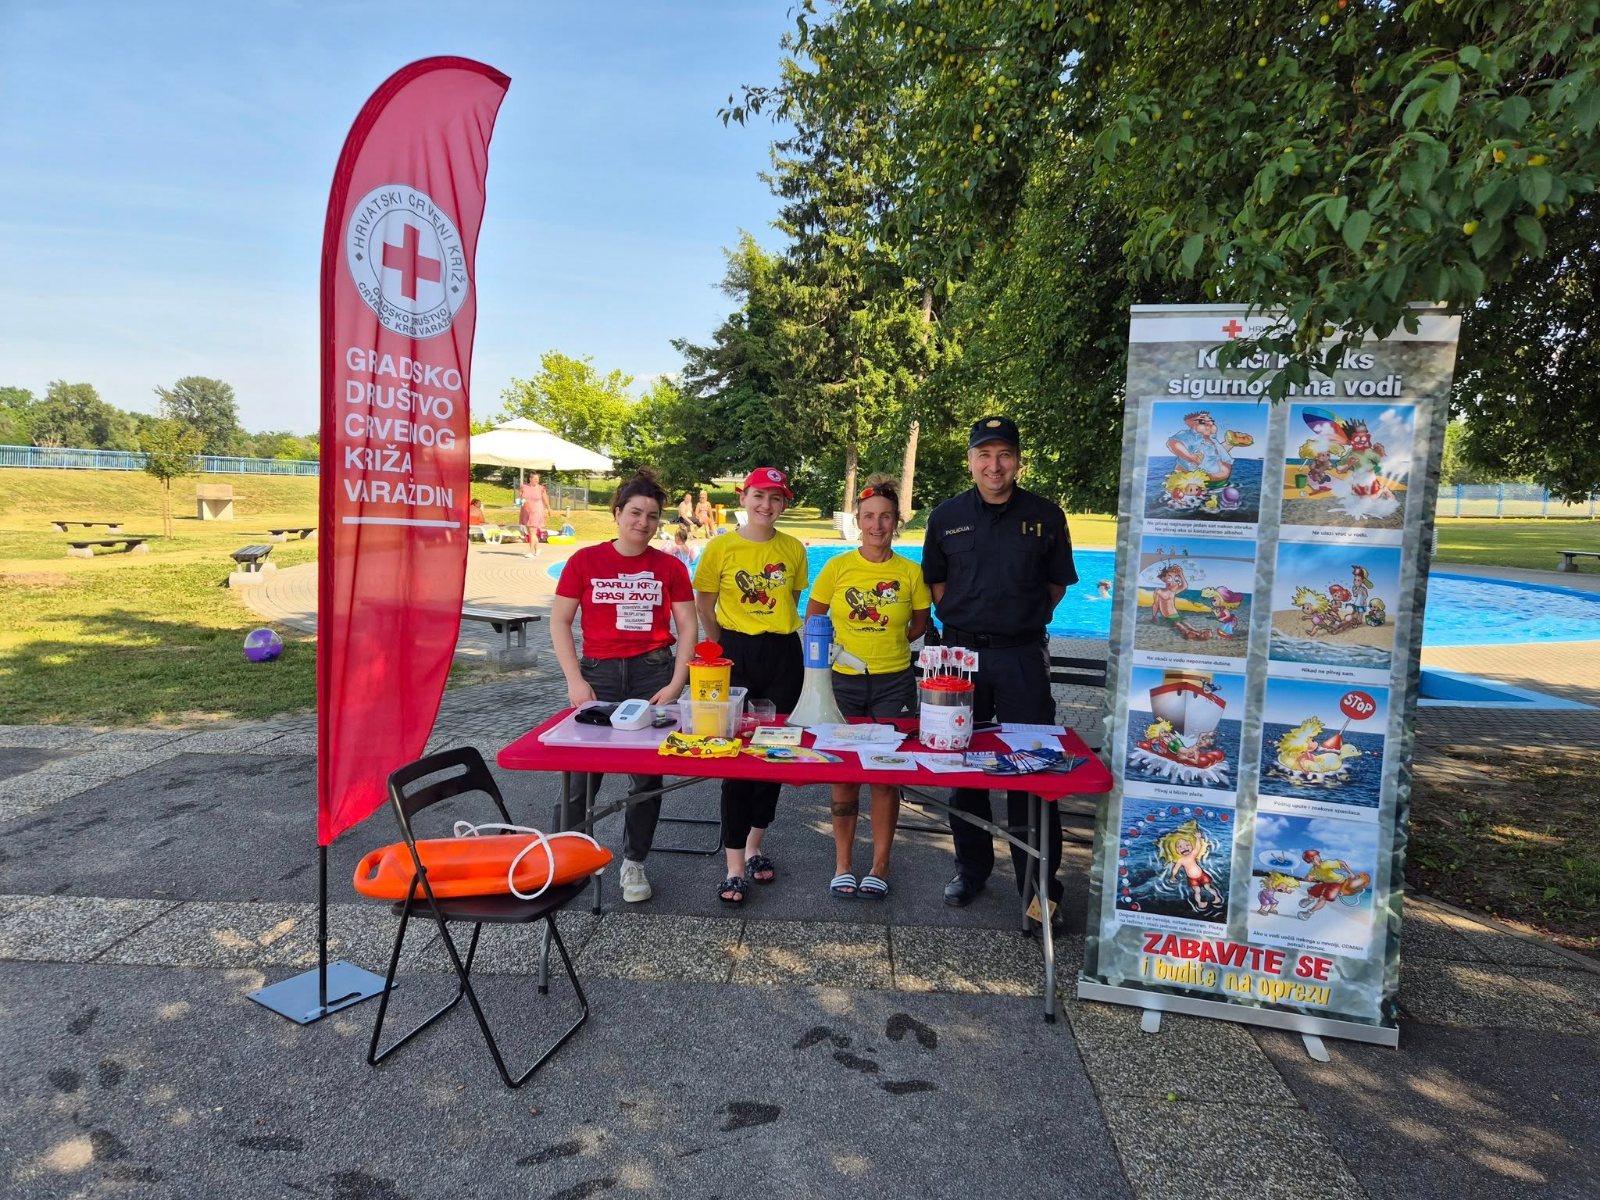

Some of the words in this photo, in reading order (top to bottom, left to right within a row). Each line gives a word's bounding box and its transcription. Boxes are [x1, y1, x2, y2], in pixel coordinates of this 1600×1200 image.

[353, 192, 402, 249] HRVATSKI
[408, 193, 454, 241] CRVENI
[448, 244, 467, 284] KRIŽ
[345, 347, 462, 391] GRADSKO
[1303, 379, 1336, 396] na
[1344, 374, 1402, 396] vodi
[345, 380, 454, 420] DRUŠTVO
[344, 413, 456, 450] CRVENOG
[344, 443, 412, 473] KRIŽA
[343, 478, 453, 508] VARAŽDIN
[945, 526, 970, 536] POLICIJA
[595, 581, 634, 589] DARUJ
[595, 591, 625, 601] SPASI
[628, 590, 660, 602] ŽIVOT
[1143, 933, 1286, 975] ZABAVITE
[1295, 955, 1333, 981] SE
[1142, 956, 1149, 976] i
[1155, 958, 1216, 988] budite
[1225, 971, 1252, 993] na
[1259, 976, 1331, 1006] oprezu
